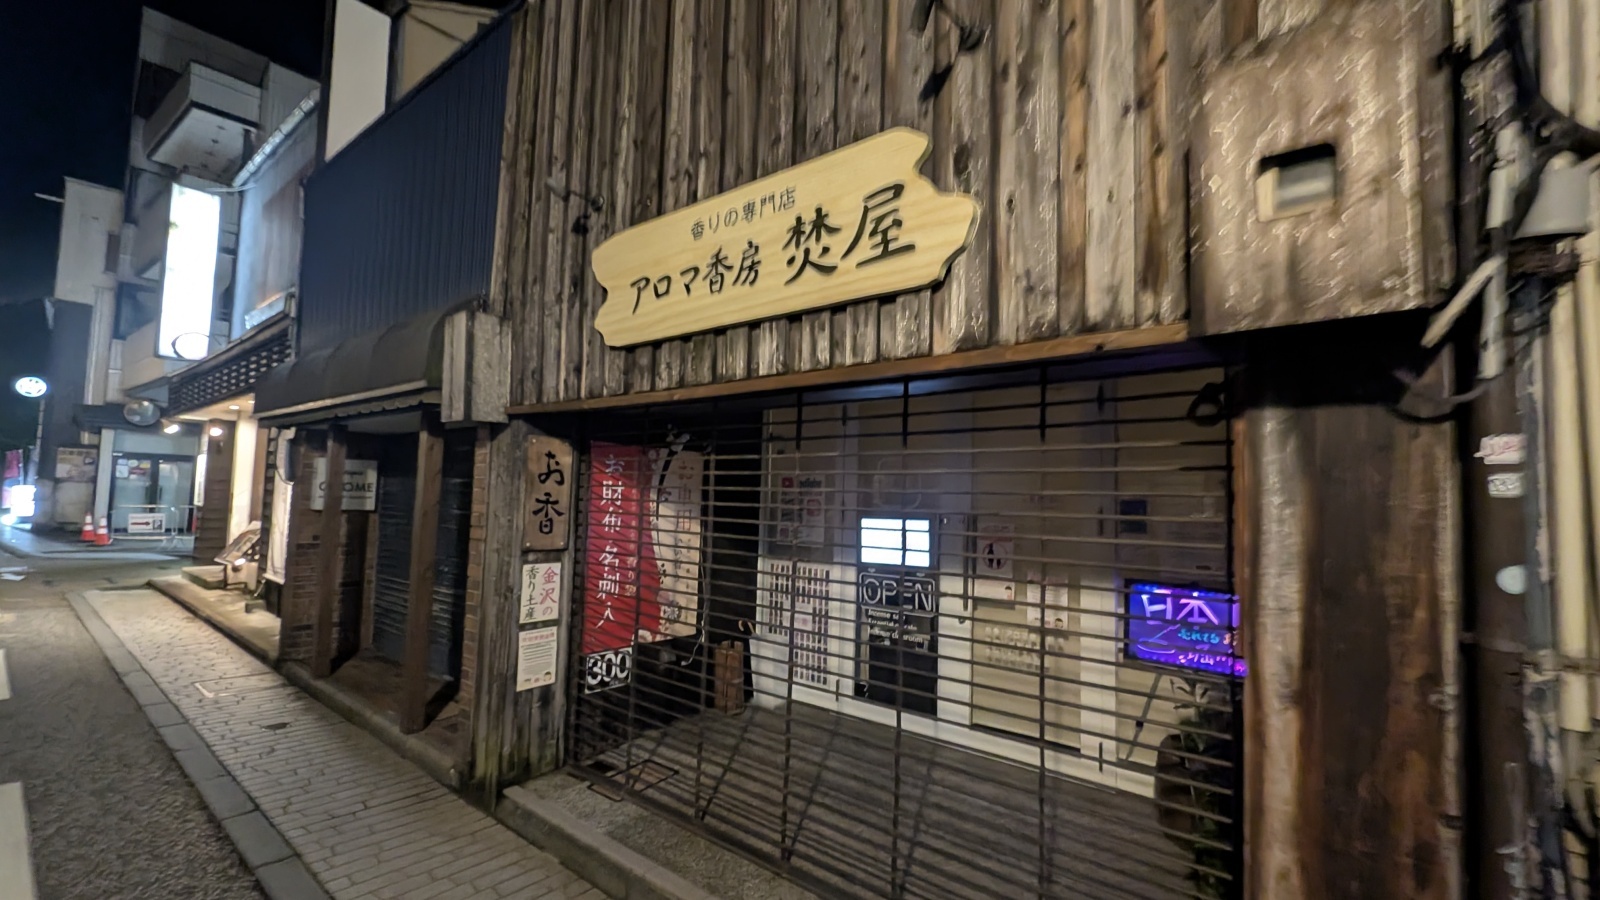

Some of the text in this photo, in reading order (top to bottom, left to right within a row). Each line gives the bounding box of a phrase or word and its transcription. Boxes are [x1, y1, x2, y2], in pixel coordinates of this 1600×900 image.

[690, 185, 798, 242] 香りの専門店
[629, 182, 917, 316] アロマ香房 焚屋
[531, 450, 565, 535] お香
[522, 564, 540, 622] 香り土産
[539, 566, 559, 616] 金沢の
[863, 578, 932, 612] OPEN
[587, 652, 629, 685] 300
